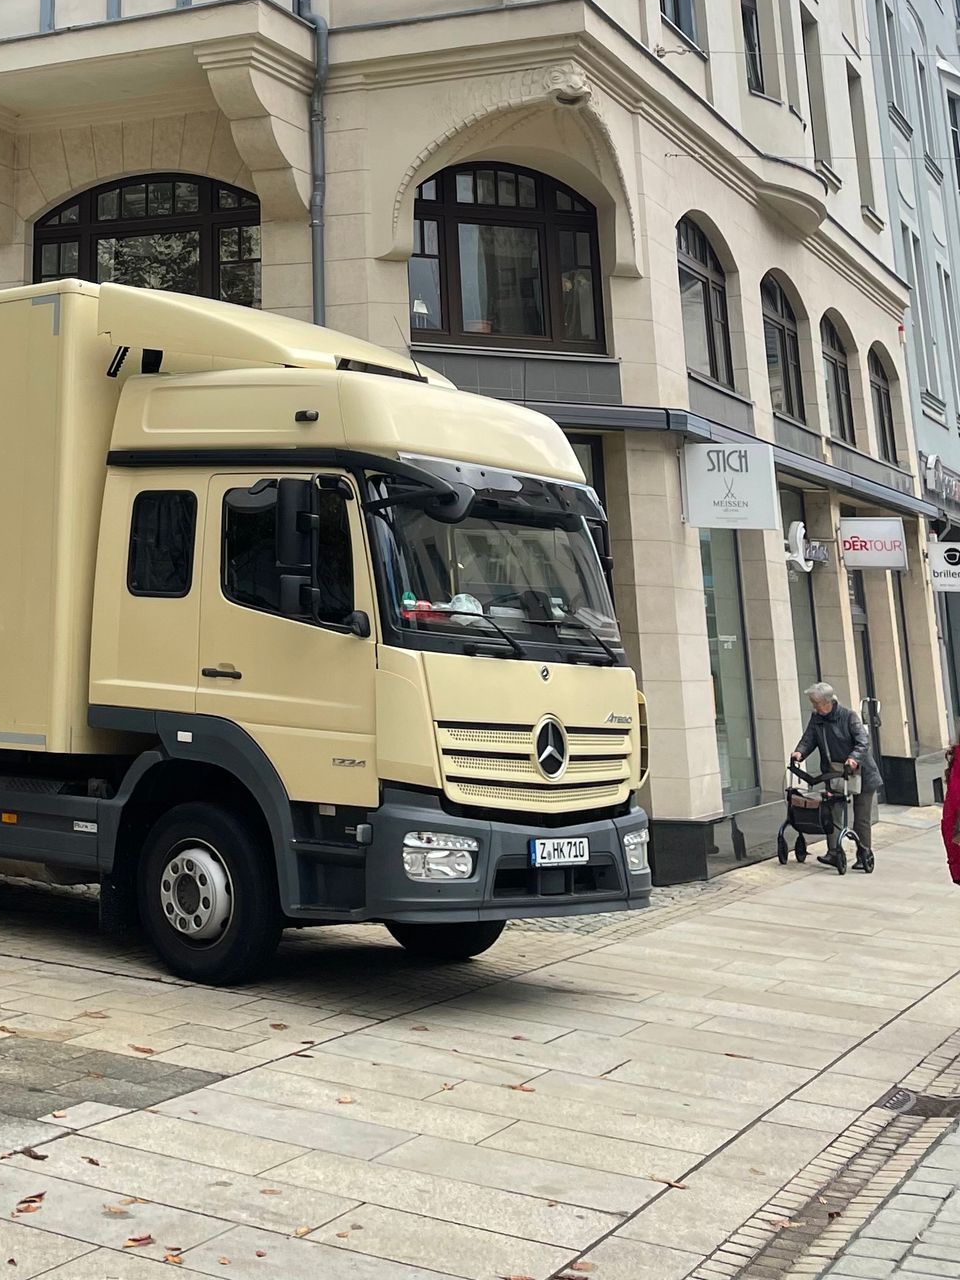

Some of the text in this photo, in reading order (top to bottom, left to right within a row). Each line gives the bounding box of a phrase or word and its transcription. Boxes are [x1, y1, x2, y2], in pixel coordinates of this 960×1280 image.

[707, 450, 749, 473] STICH
[713, 500, 749, 508] MEISSEN
[843, 537, 902, 552] DERTOUR
